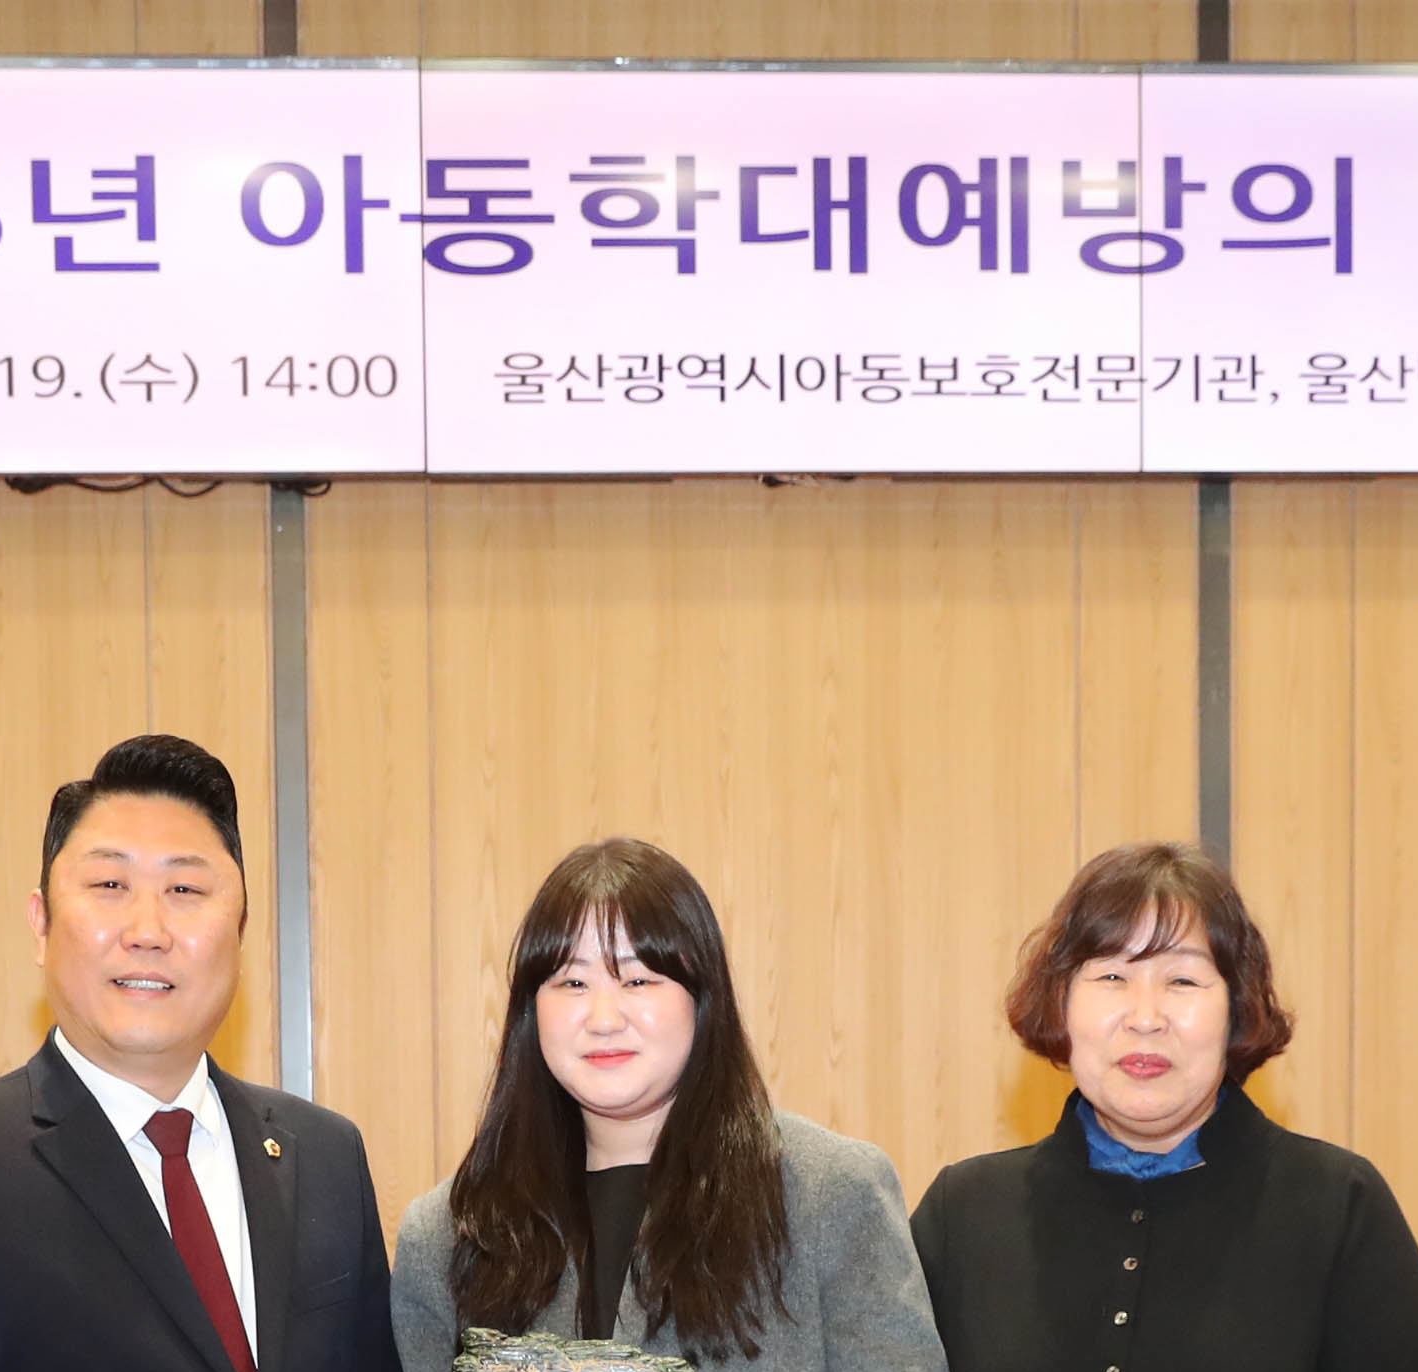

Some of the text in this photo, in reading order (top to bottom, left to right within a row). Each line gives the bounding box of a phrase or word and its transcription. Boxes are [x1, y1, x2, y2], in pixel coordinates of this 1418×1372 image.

[239, 154, 1354, 278] 아동학대예방의
[231, 353, 399, 400] 14:00
[493, 352, 1280, 405] 울산광역시아동보호전문기관,
